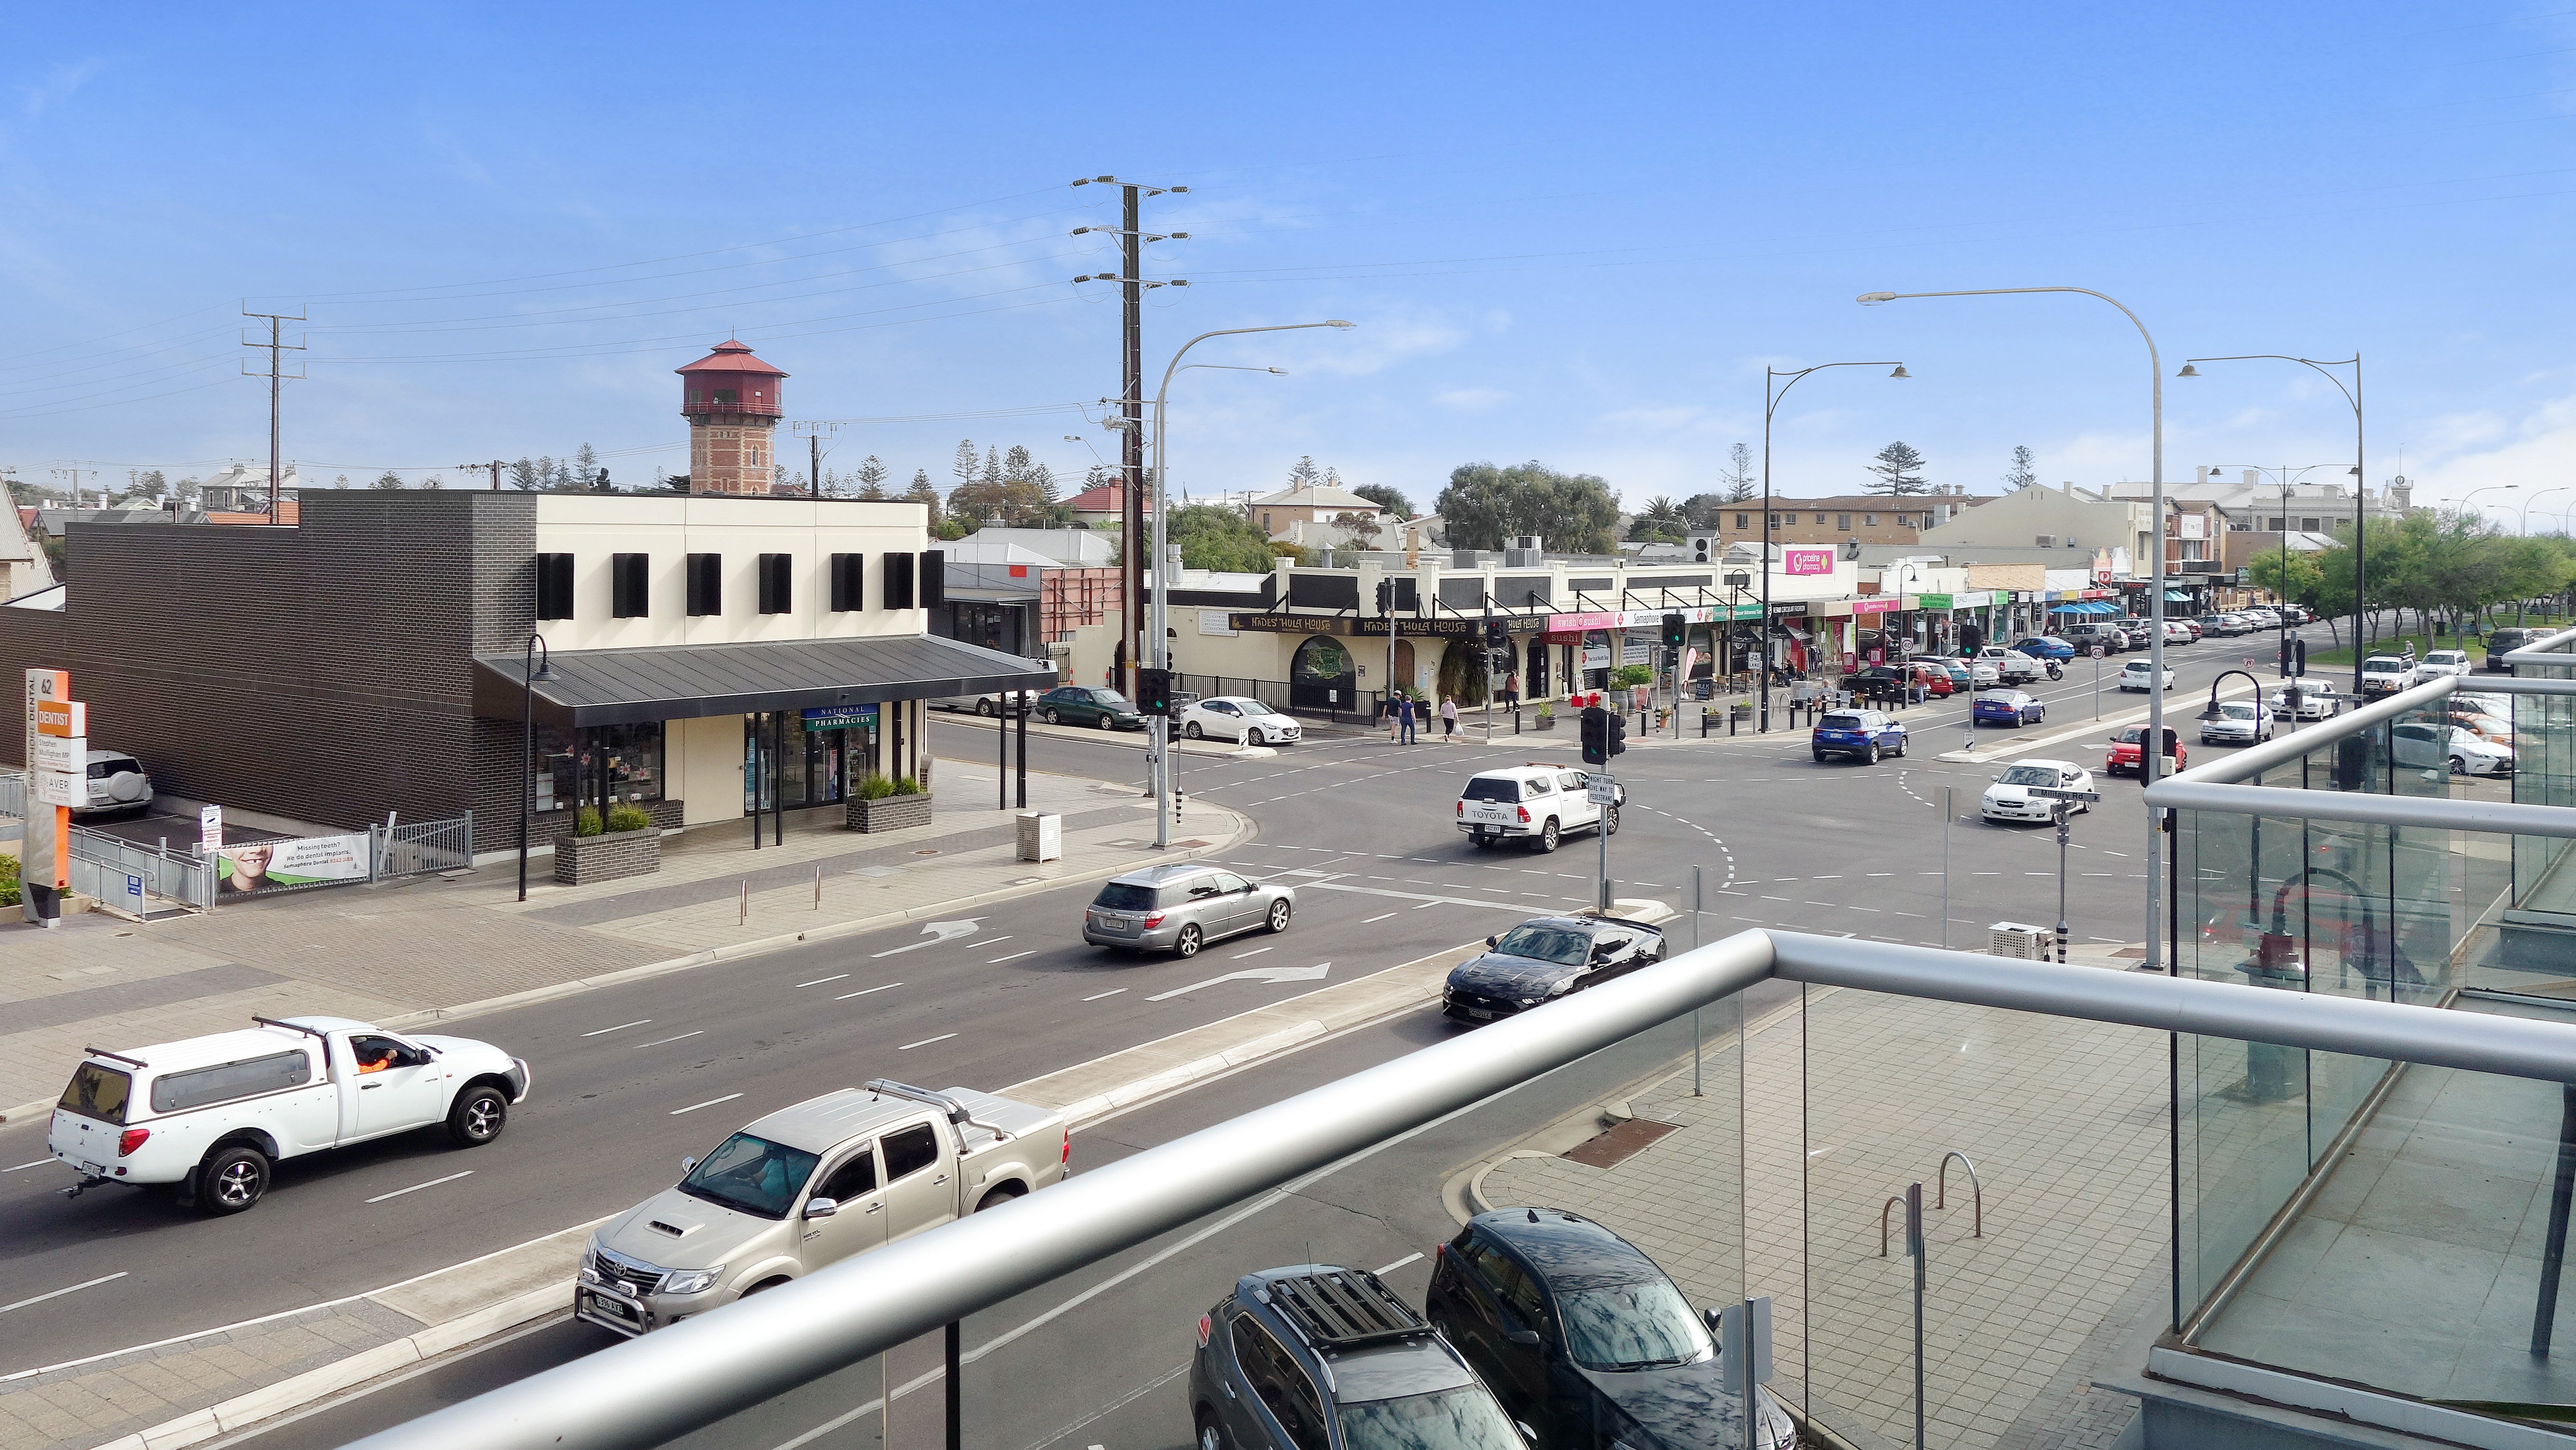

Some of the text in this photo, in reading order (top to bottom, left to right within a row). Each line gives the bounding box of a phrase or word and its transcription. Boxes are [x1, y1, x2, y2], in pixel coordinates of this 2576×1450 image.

[1803, 554, 1820, 563] priceline
[1803, 564, 1820, 572] pharmacy
[1251, 617, 1278, 628] HADES
[1279, 618, 1303, 628] HULA
[1506, 619, 1522, 629] HULA
[1557, 615, 1601, 628] swish sushi
[1634, 613, 1659, 625] Semaphore
[1400, 621, 1430, 632] HULA
[1551, 634, 1578, 642] sushi
[41, 678, 52, 694] 62
[821, 706, 864, 715] NATIONAL
[39, 710, 69, 726] DENTIST
[815, 716, 870, 727] PHARMACIES
[49, 778, 69, 790] AVER
[1590, 793, 1612, 802] PEDESTRIANS
[2041, 790, 2070, 799] Military
[1472, 810, 1508, 821] TOYOTA
